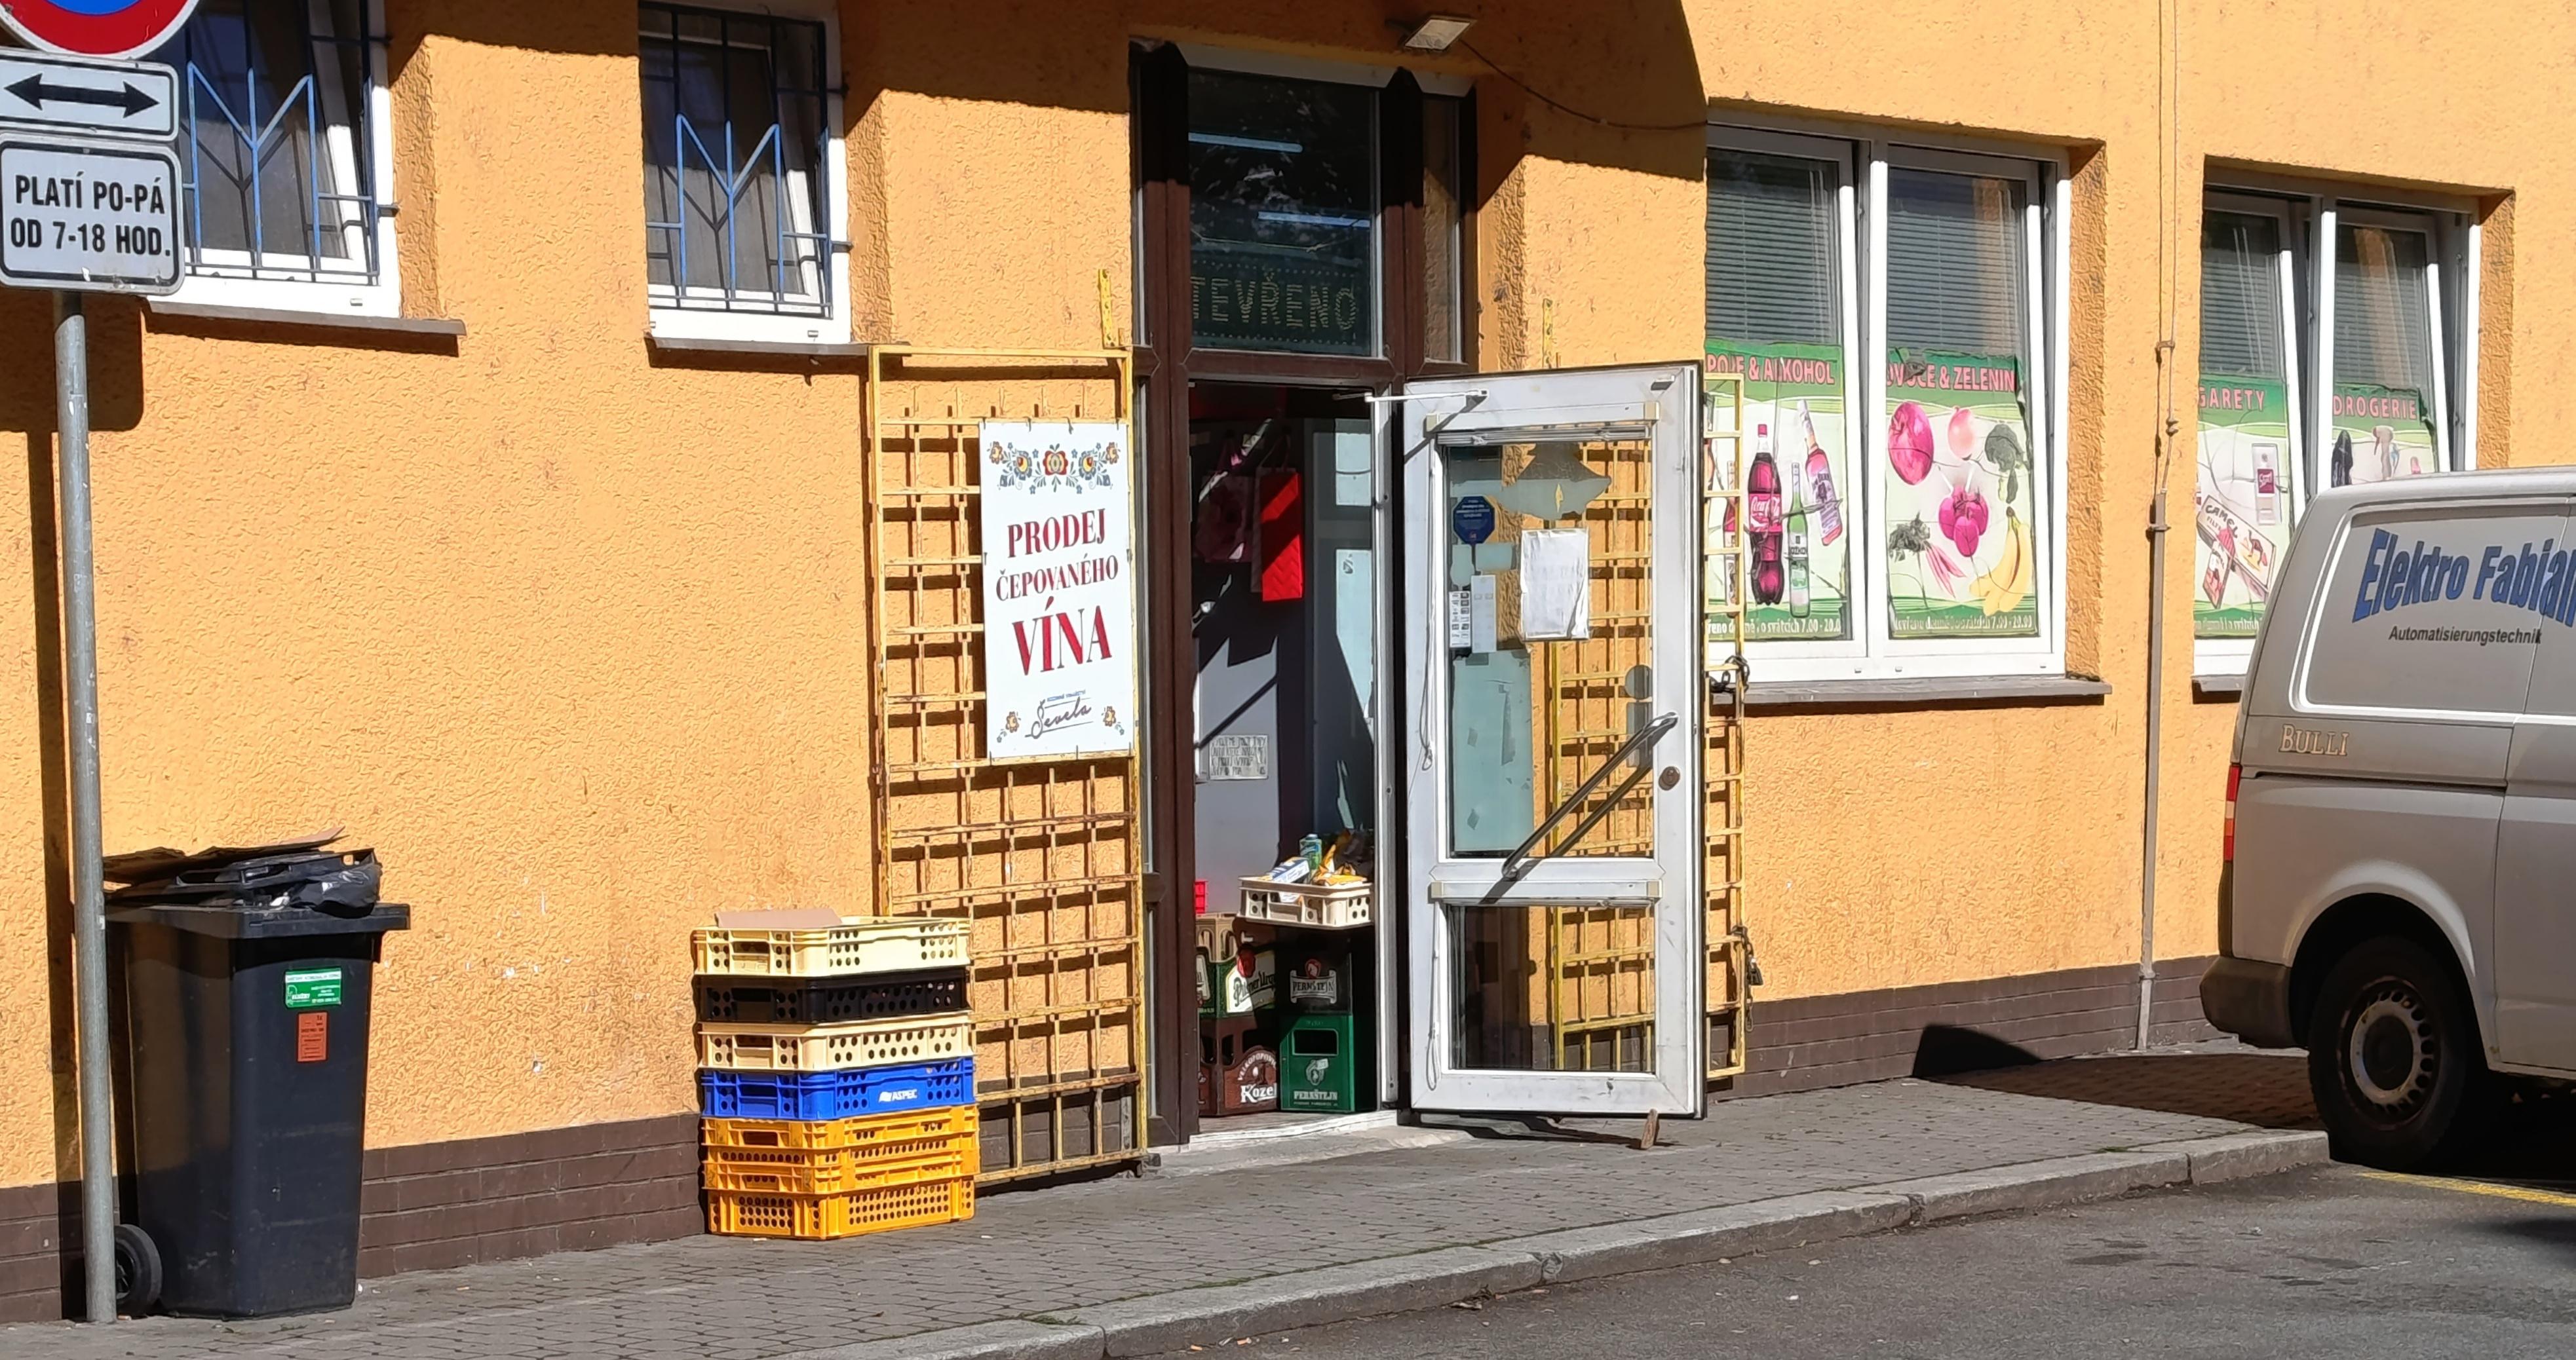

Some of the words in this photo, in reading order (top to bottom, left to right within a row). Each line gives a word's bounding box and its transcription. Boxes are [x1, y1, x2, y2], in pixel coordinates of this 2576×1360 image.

[16, 171, 84, 208] PLATÍ
[93, 177, 164, 214] PO-PÁ
[10, 217, 42, 248] OD
[52, 221, 106, 253] 7-18
[115, 225, 170, 256] HOD.
[1748, 356, 1761, 382] &
[1763, 356, 1835, 385] ALKOHOL
[1939, 364, 1950, 390] &
[2332, 394, 2417, 420] DROGERIE
[1007, 508, 1105, 558] PRODEJ
[2205, 504, 2238, 538] CAMEL
[996, 554, 1119, 601] ČEPOVANÉHO
[2352, 527, 2470, 623] Elektro
[1012, 596, 1112, 676] VÍNA
[2388, 626, 2542, 646] Automatisierungstechnik
[2278, 723, 2349, 756] BULLI
[1240, 1083, 1277, 1103] Kozel
